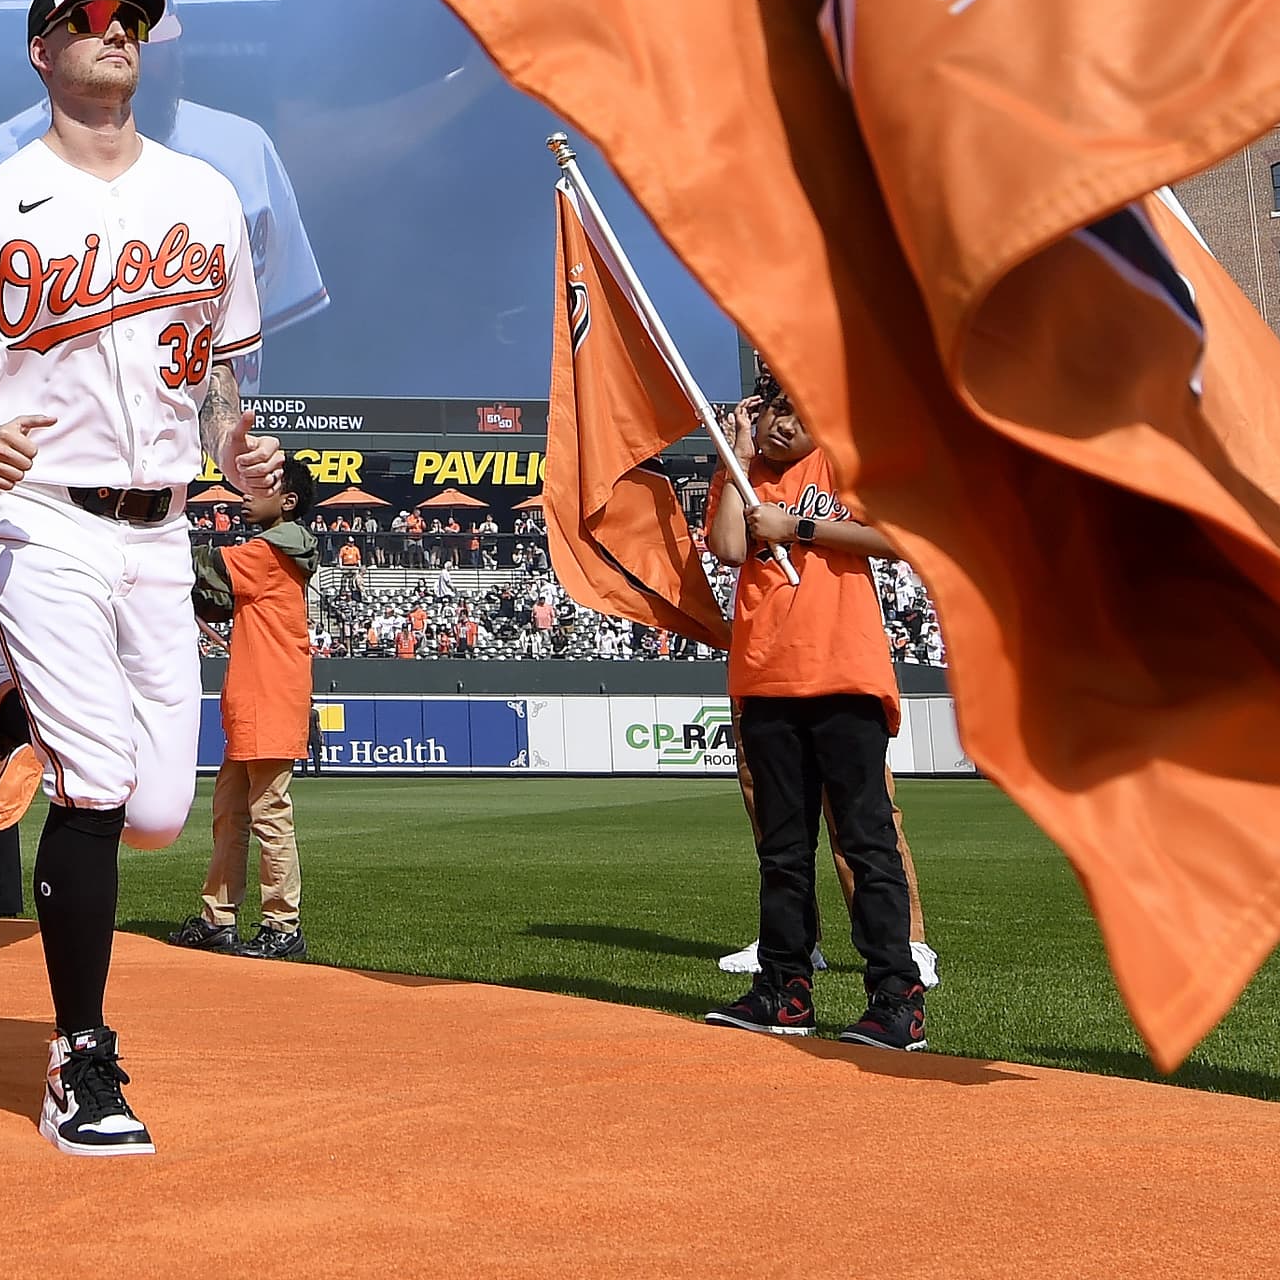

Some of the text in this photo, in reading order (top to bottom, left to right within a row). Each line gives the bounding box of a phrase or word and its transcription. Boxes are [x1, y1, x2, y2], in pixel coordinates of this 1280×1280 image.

[158, 322, 213, 389] 38
[240, 400, 306, 413] HANDED
[295, 417, 363, 430] ANDREW
[349, 738, 448, 764] Health
